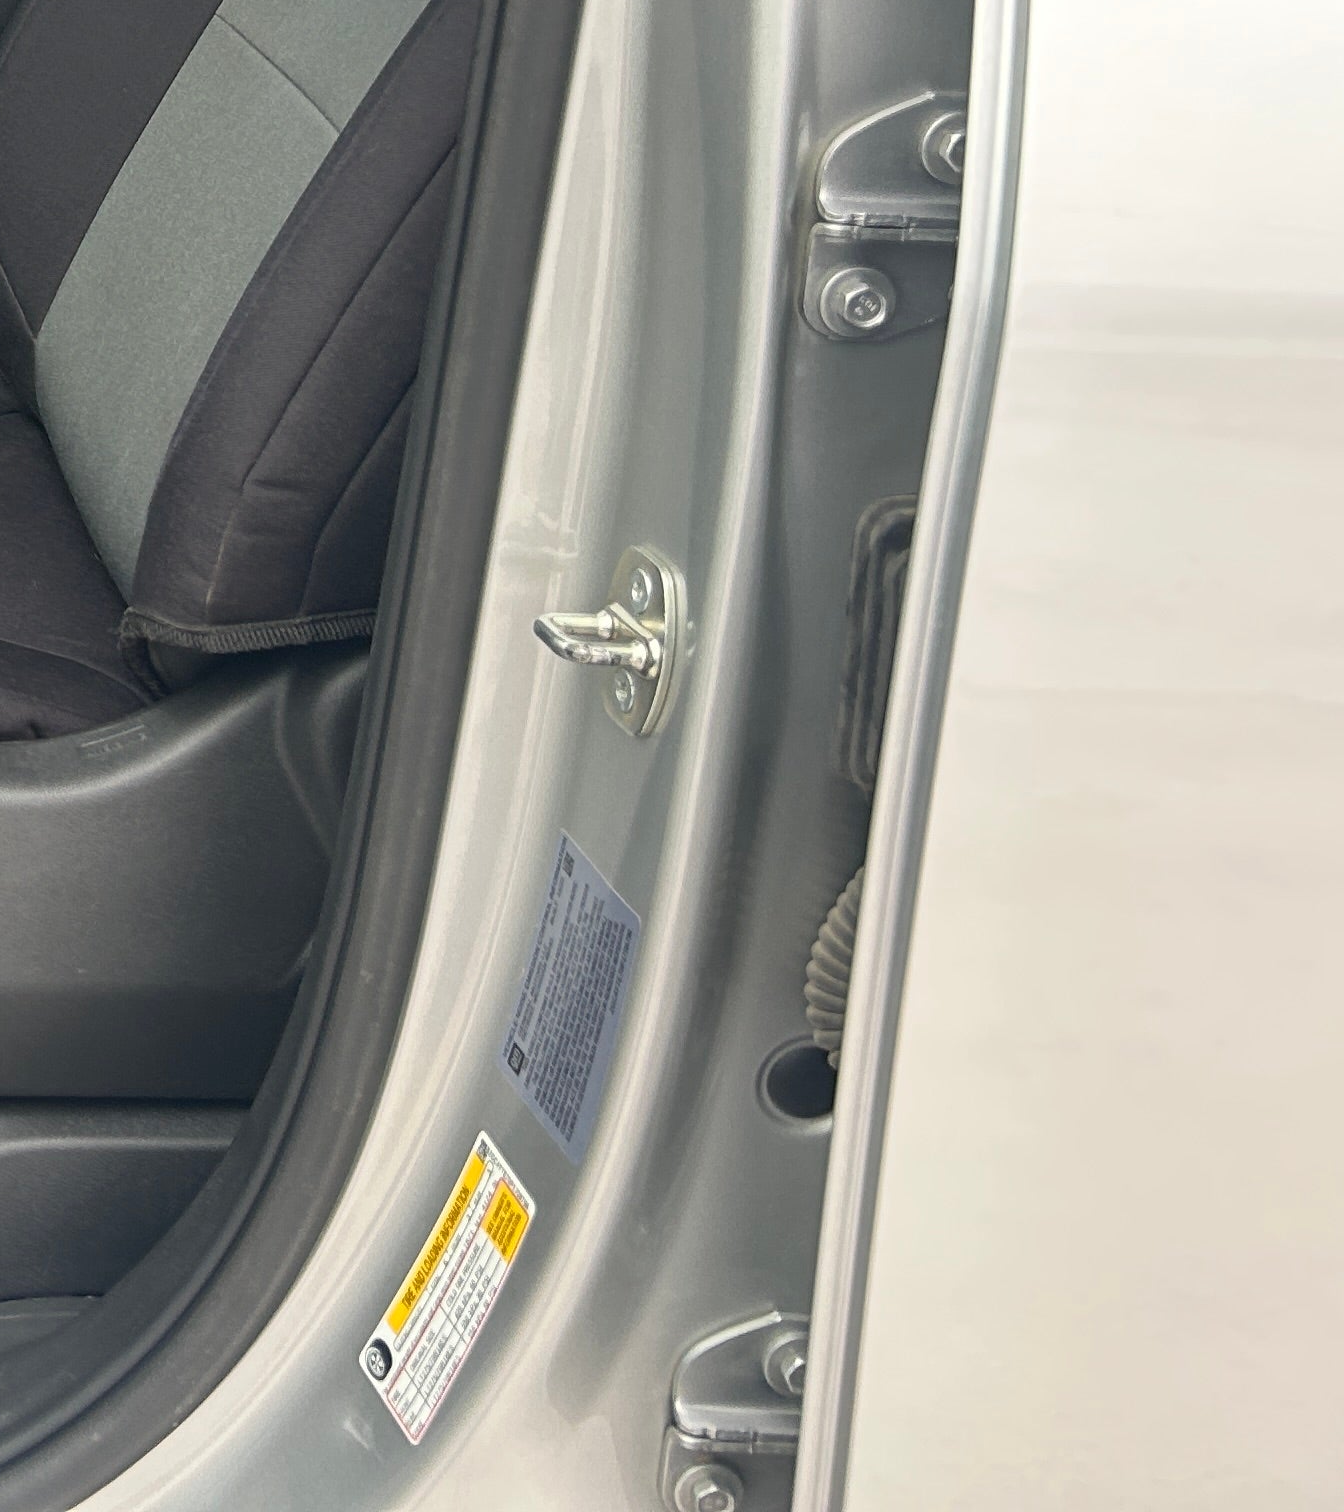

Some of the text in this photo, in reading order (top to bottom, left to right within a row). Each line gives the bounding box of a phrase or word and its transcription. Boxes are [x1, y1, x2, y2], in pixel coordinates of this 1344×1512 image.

[401, 1182, 471, 1311] TIRE AND LOADING INFORMATION
